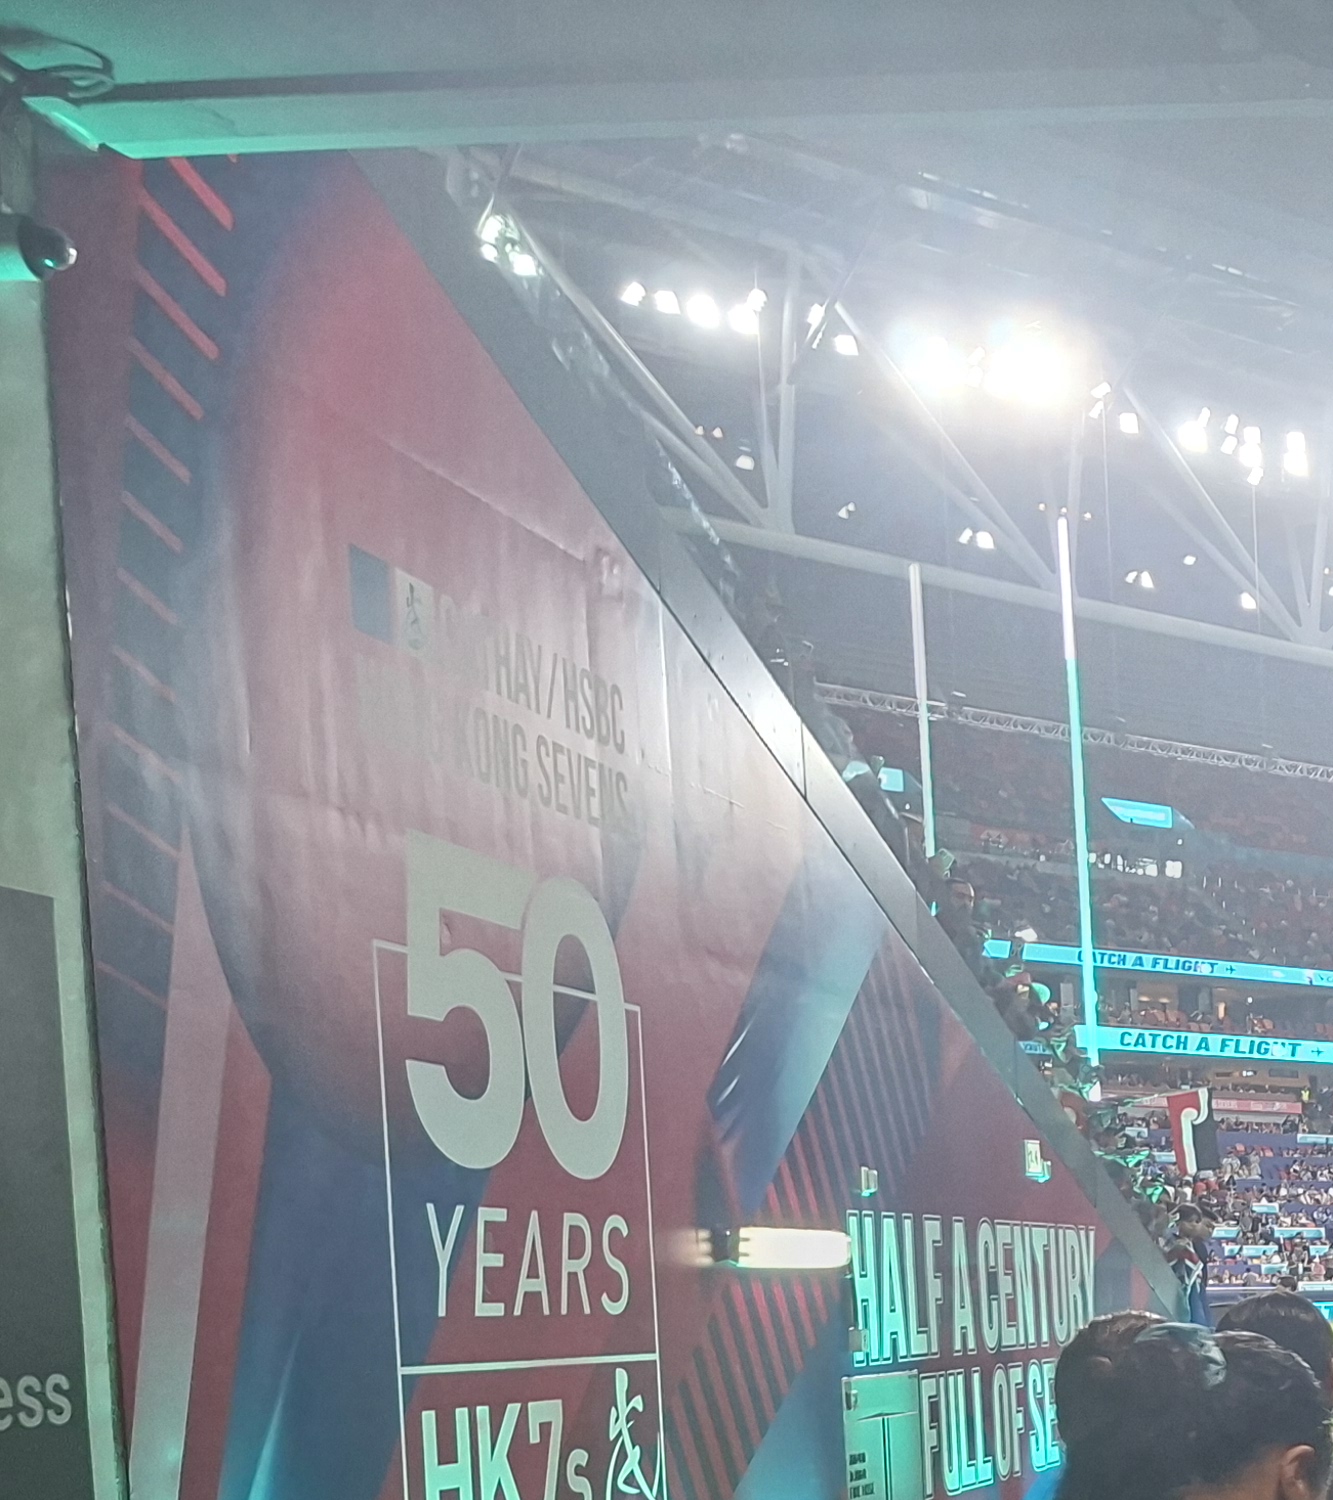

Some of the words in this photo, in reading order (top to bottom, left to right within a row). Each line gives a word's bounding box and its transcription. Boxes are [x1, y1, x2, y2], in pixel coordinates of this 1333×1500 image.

[405, 828, 629, 1180] 50
[1131, 956, 1144, 968] A
[1120, 1030, 1189, 1052] CATCH
[1195, 1035, 1211, 1053] A
[426, 1203, 630, 1319] YEARS
[846, 1209, 942, 1367] HALF
[952, 1216, 976, 1356] A
[976, 1217, 1095, 1352] CENTURY
[919, 1366, 995, 1500] FULL
[992, 1362, 1027, 1482] OF
